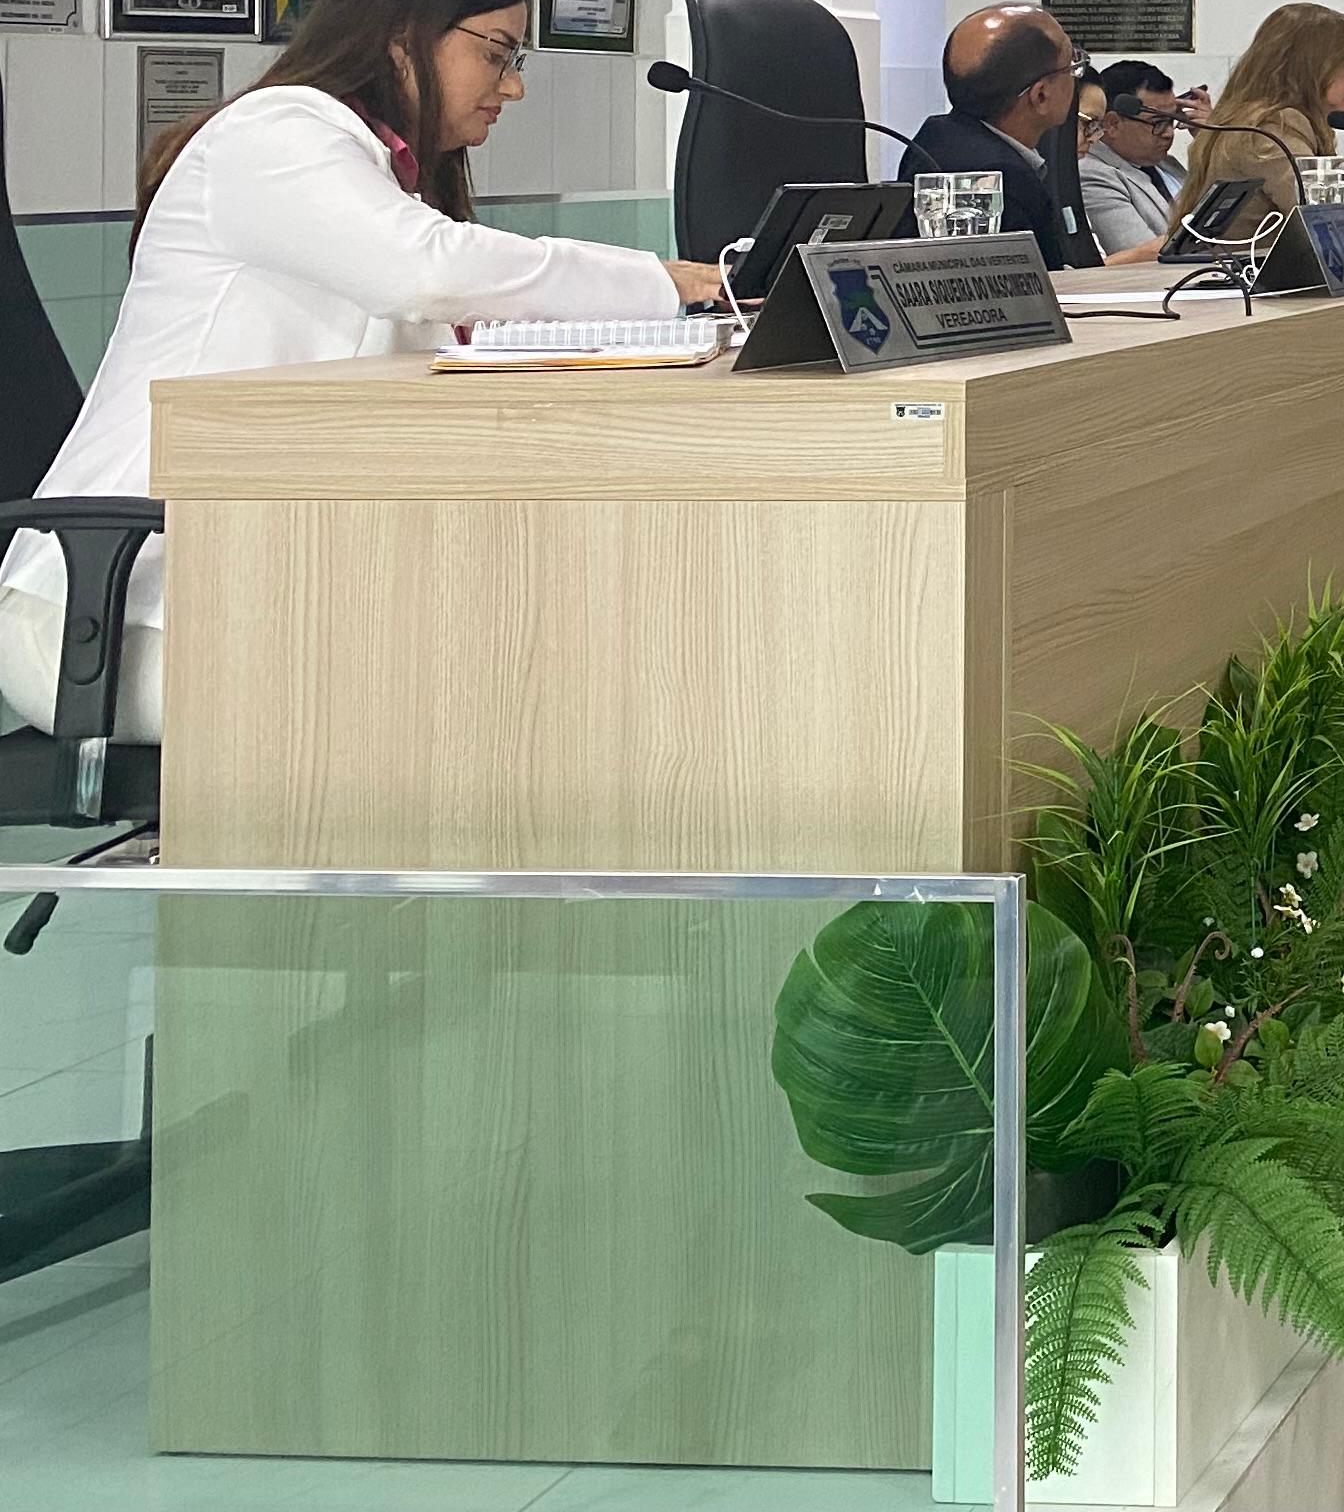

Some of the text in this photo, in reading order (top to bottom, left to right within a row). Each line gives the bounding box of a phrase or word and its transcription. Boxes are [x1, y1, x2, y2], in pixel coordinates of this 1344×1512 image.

[929, 257, 970, 271] MUNICIPAL
[969, 256, 986, 268] DAS
[986, 254, 1030, 267] VERTENTES
[895, 271, 1045, 308] SAARA SIQUEIRA DO NASCIMENTO
[936, 307, 1008, 329] VEREADORA
